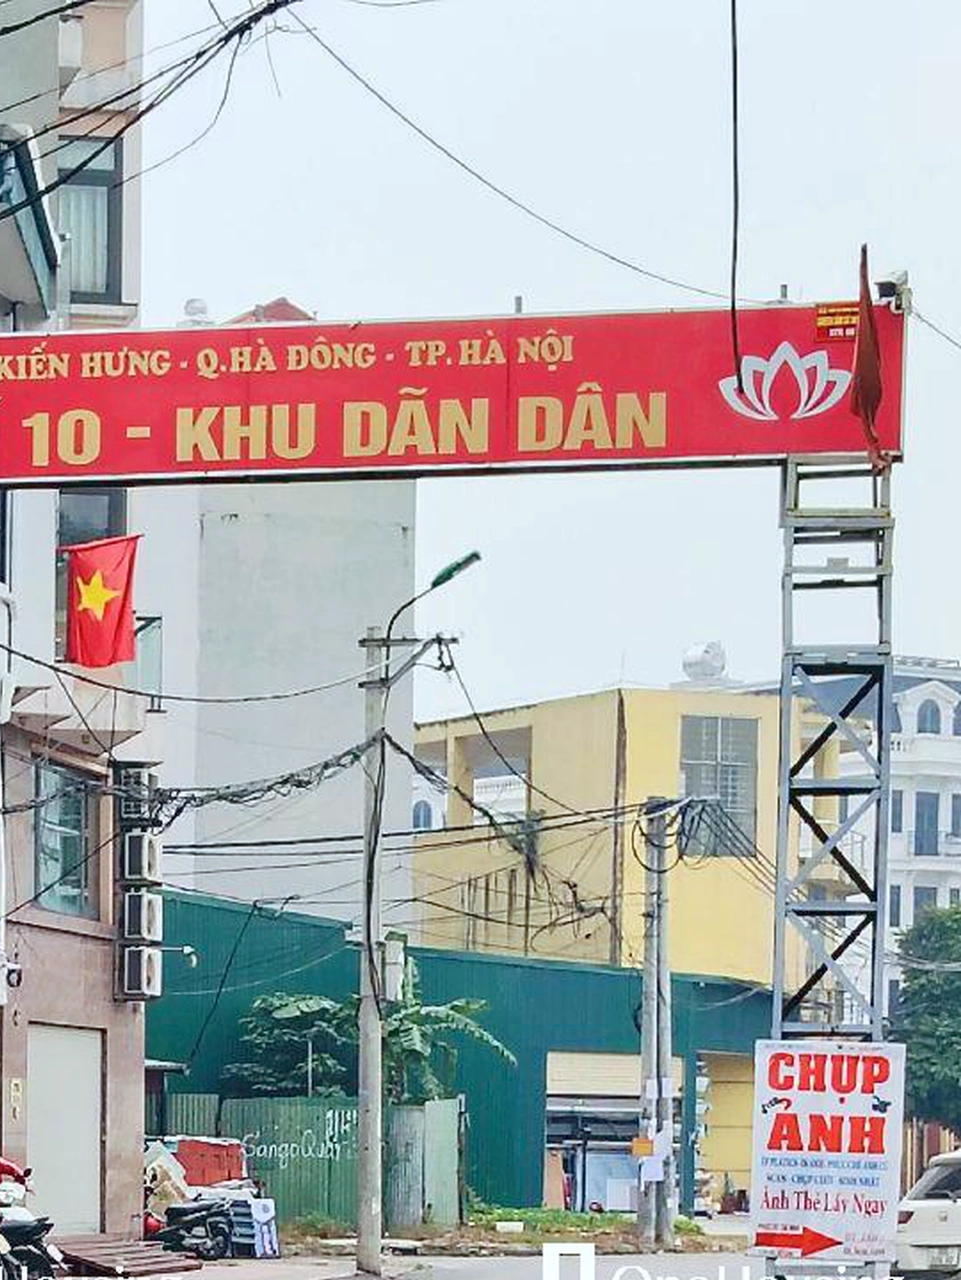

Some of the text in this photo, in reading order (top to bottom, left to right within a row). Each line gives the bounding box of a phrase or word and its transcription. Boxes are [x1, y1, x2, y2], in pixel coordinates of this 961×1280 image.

[81, 347, 171, 378] HƯNG
[287, 336, 376, 371] ĐÔNG
[458, 330, 506, 366] HÀ
[517, 328, 574, 371] NỘI
[21, 408, 101, 467] 10
[176, 403, 316, 462] KHU
[343, 386, 489, 457] DÃN
[518, 381, 666, 452] DÂN
[767, 1051, 891, 1105] CHỤP
[767, 1097, 887, 1156] ẢNH
[853, 1192, 888, 1218] Ngay
